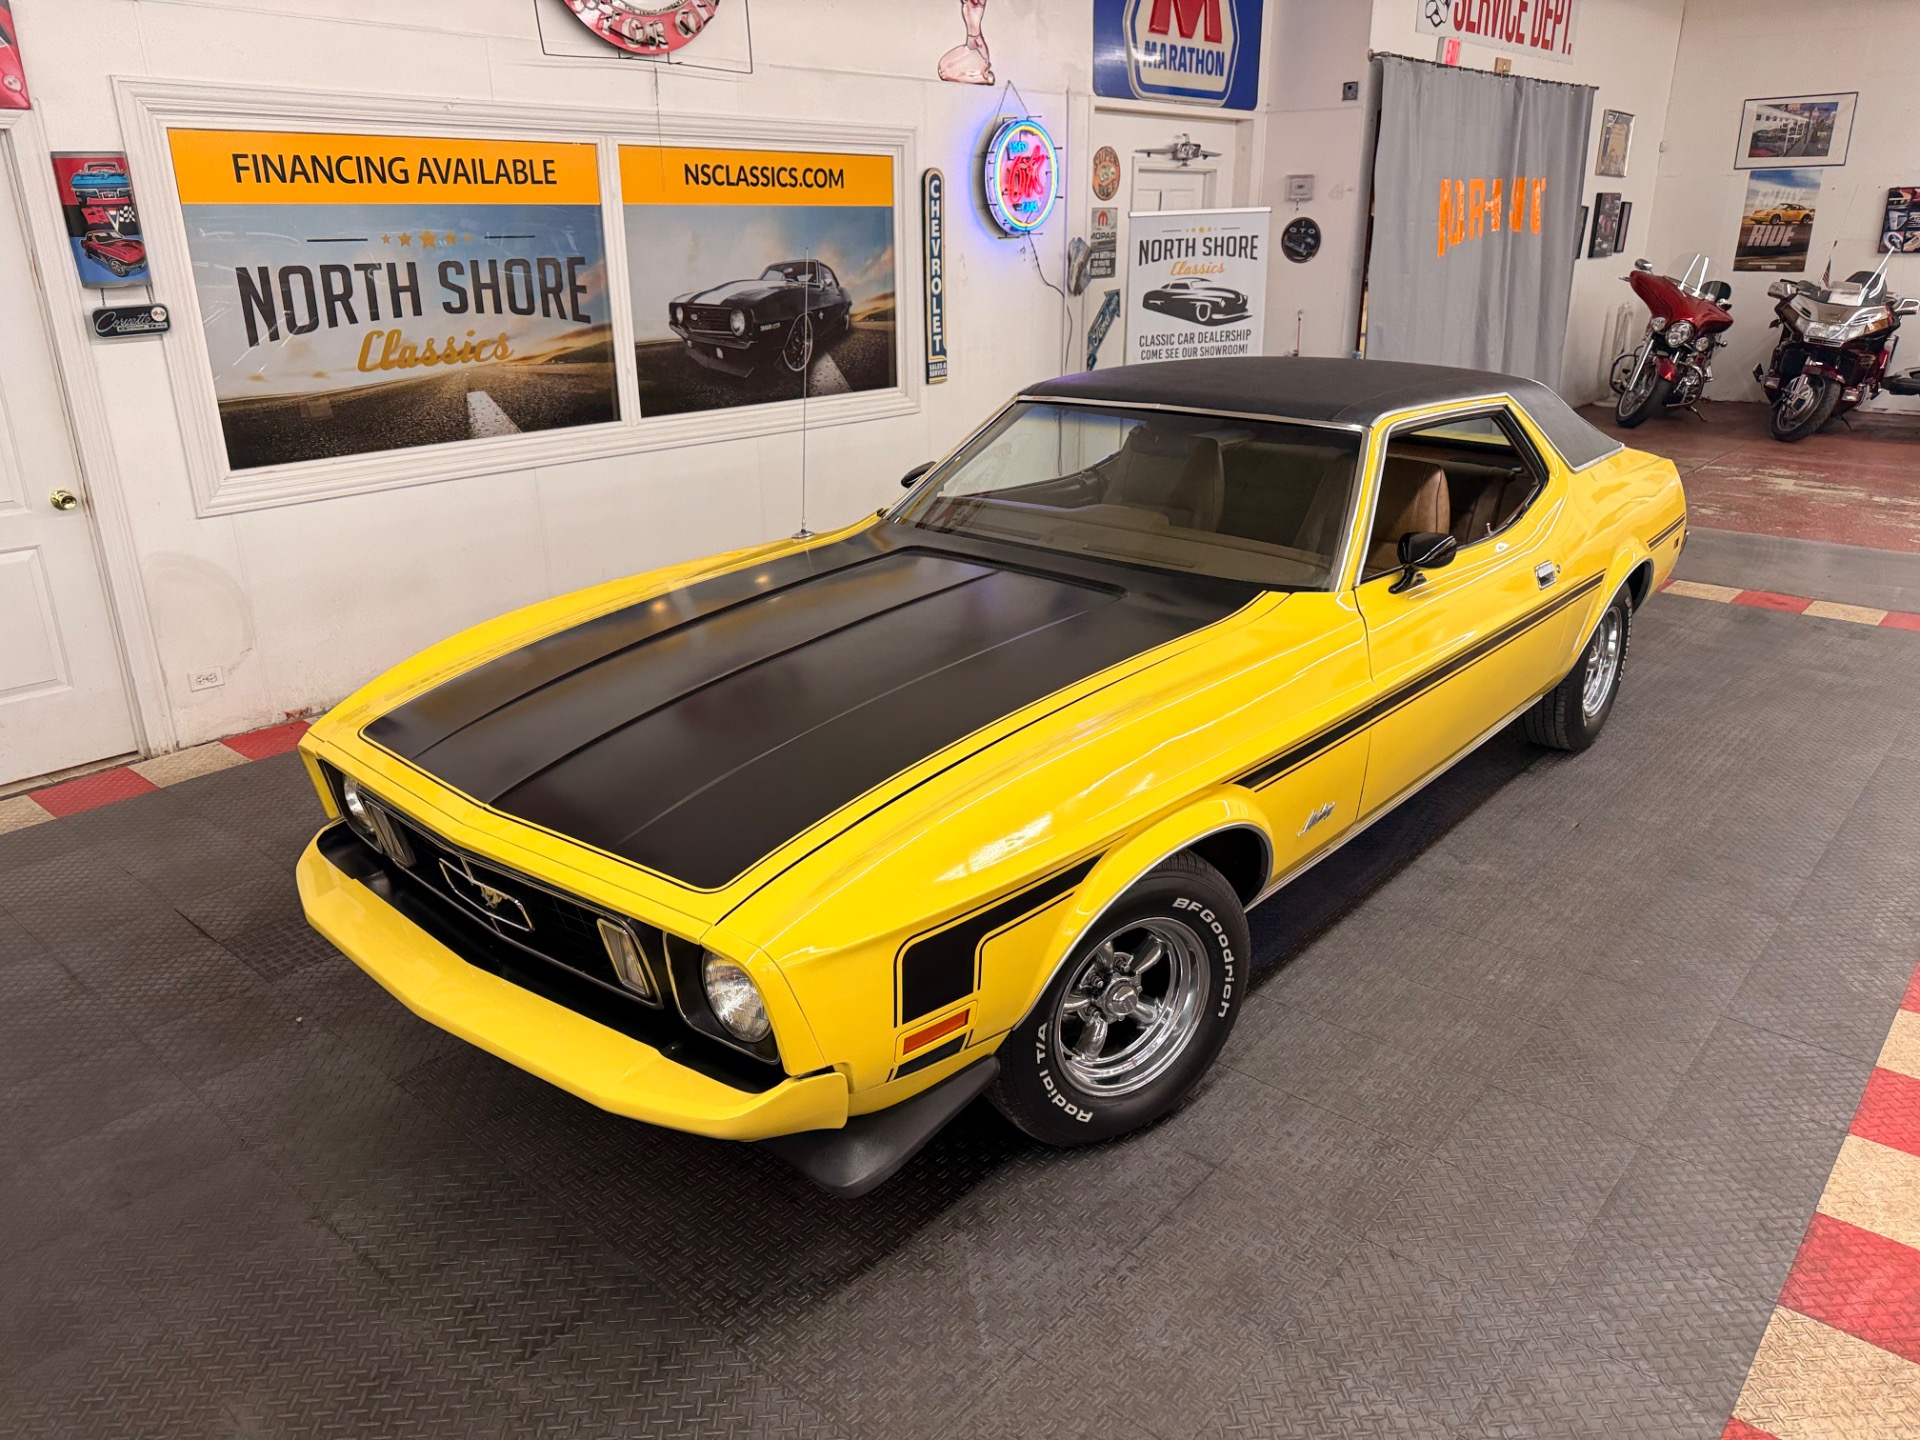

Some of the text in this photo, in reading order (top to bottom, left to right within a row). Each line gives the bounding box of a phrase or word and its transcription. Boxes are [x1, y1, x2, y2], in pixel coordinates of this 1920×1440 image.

[1143, 41, 1225, 76] MARATHON
[232, 153, 558, 185] FINANCING AVAILABLE
[684, 163, 845, 188] NSCLASSICS.COM
[1289, 226, 1316, 234] GTO
[1746, 224, 1795, 247] RIDE
[929, 179, 943, 352] CHEVROLET
[1138, 234, 1259, 267] NORTH SHORE
[1169, 260, 1225, 276] Classics
[235, 256, 592, 348] NORTH SHORE
[95, 311, 154, 333] Corvette
[1139, 328, 1252, 348] CLASSIC CAR DEALERSHIP
[357, 328, 515, 373] Classics
[1140, 343, 1248, 361] COME SEE OUR SHOWROOM!
[1172, 897, 1235, 1018] BFGoodrich
[1036, 1021, 1094, 1124] Radial T/A
